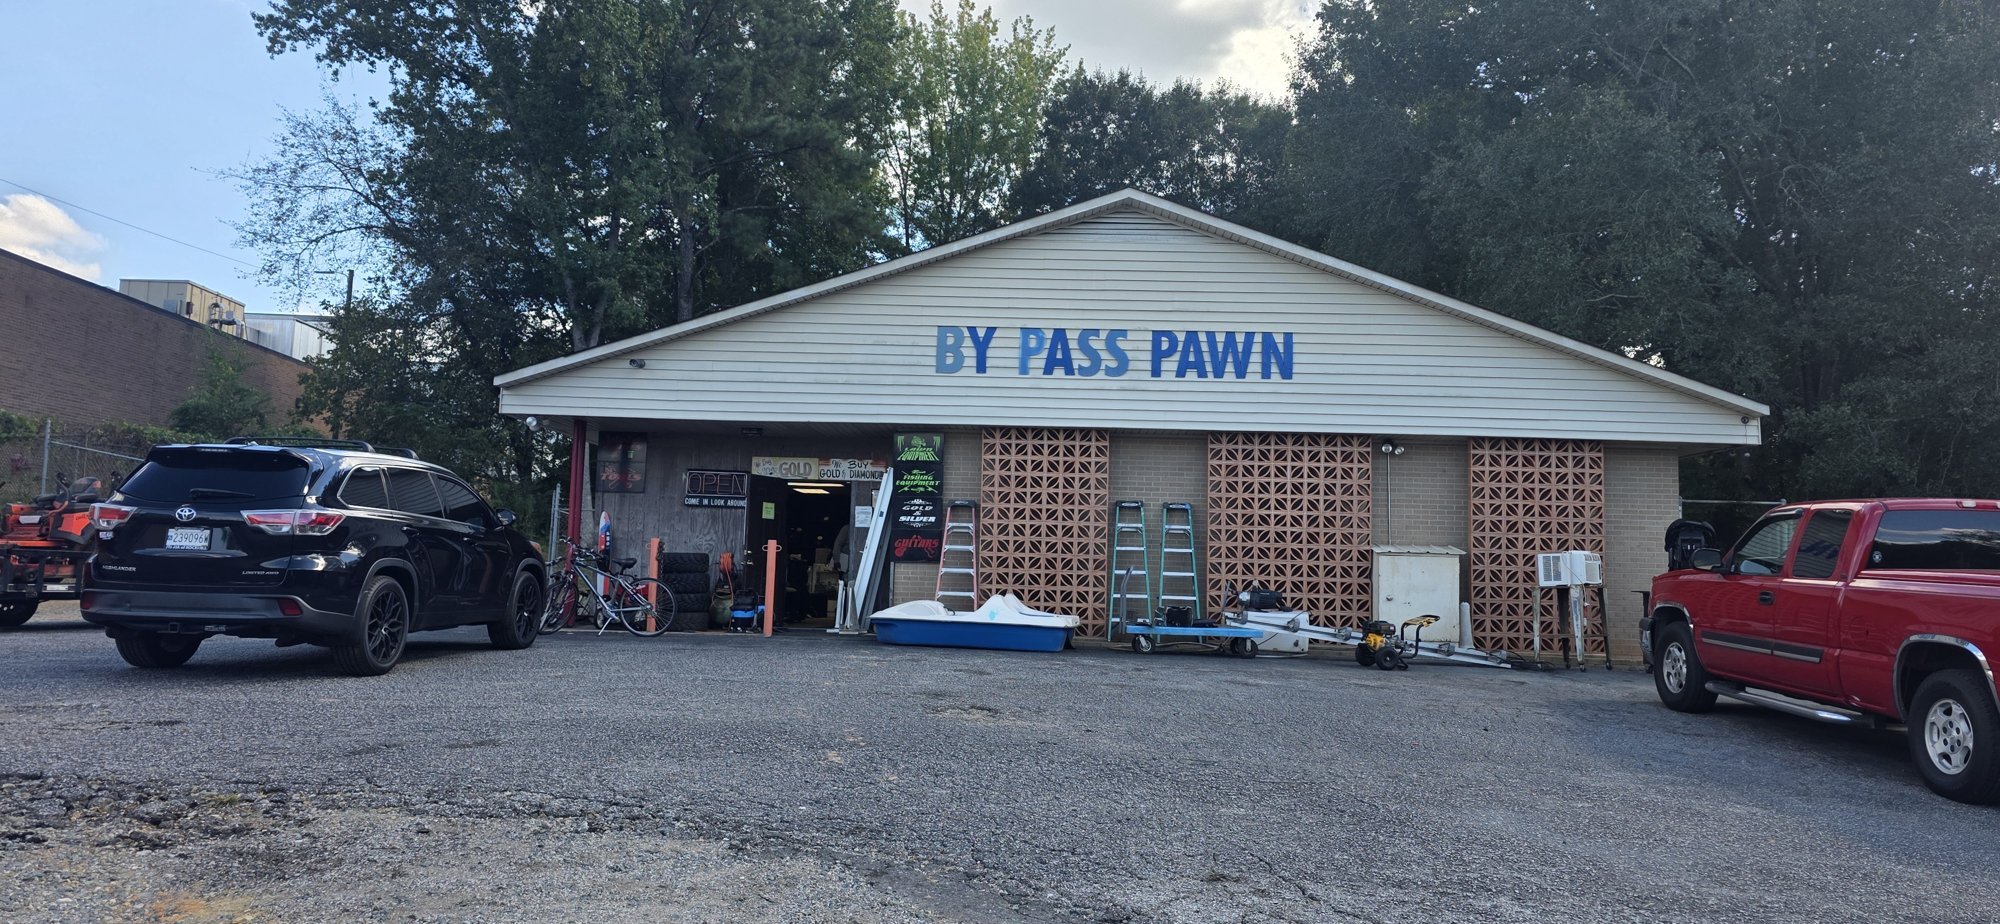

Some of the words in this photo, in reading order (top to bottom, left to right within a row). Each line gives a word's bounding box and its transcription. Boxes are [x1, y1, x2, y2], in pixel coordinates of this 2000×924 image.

[935, 326, 997, 374] BY
[1018, 327, 1131, 377] PASS
[1150, 329, 1295, 380] PAWN
[897, 451, 939, 461] EQUIPMENT
[779, 462, 812, 476] GOLD
[847, 460, 869, 469] BUY
[819, 469, 841, 478] GOLD
[688, 473, 747, 495] OPEN
[710, 498, 725, 506] LOOK
[898, 515, 937, 523] SILVER
[894, 538, 940, 548] GUITARS
